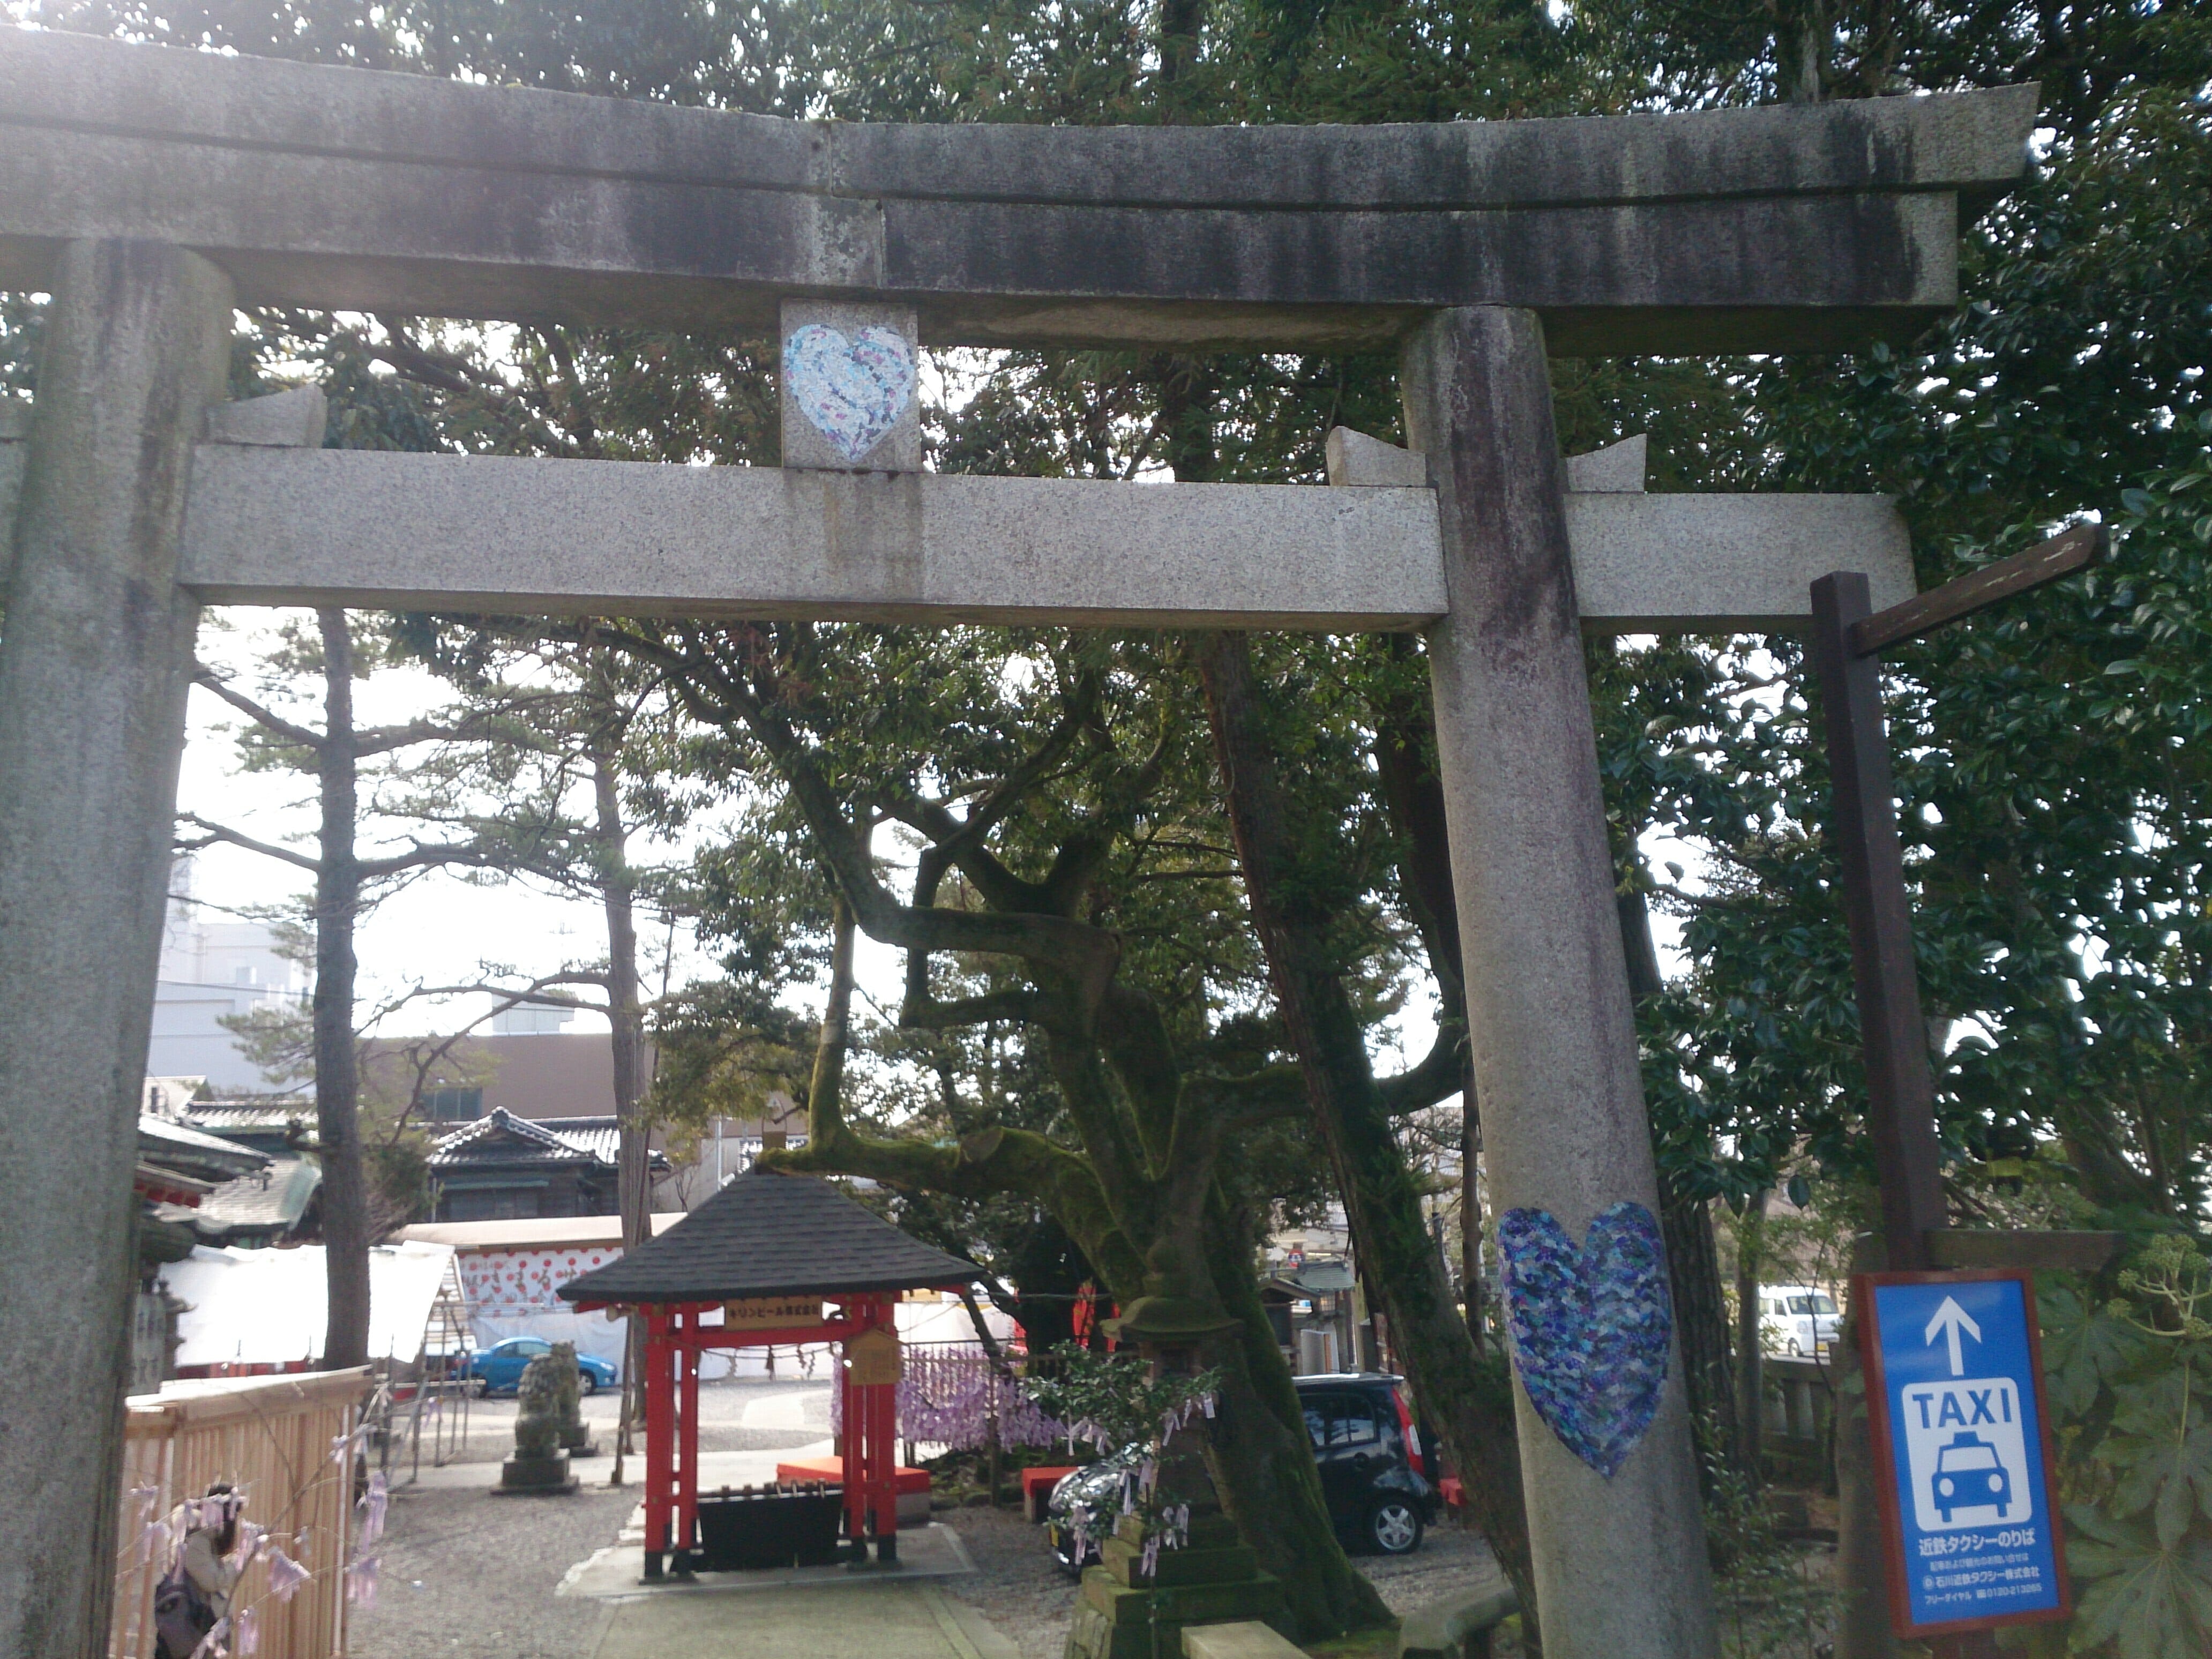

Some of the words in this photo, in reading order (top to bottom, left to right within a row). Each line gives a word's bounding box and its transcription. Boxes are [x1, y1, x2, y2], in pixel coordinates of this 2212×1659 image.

[1912, 1388, 2012, 1429] TAXI
[1919, 1528, 2035, 1556] 近鉄タクシーのりば
[1935, 1566, 2039, 1588] 石川近鉄タクシー株式会社
[1925, 1591, 1972, 1604] フリーダイヤル
